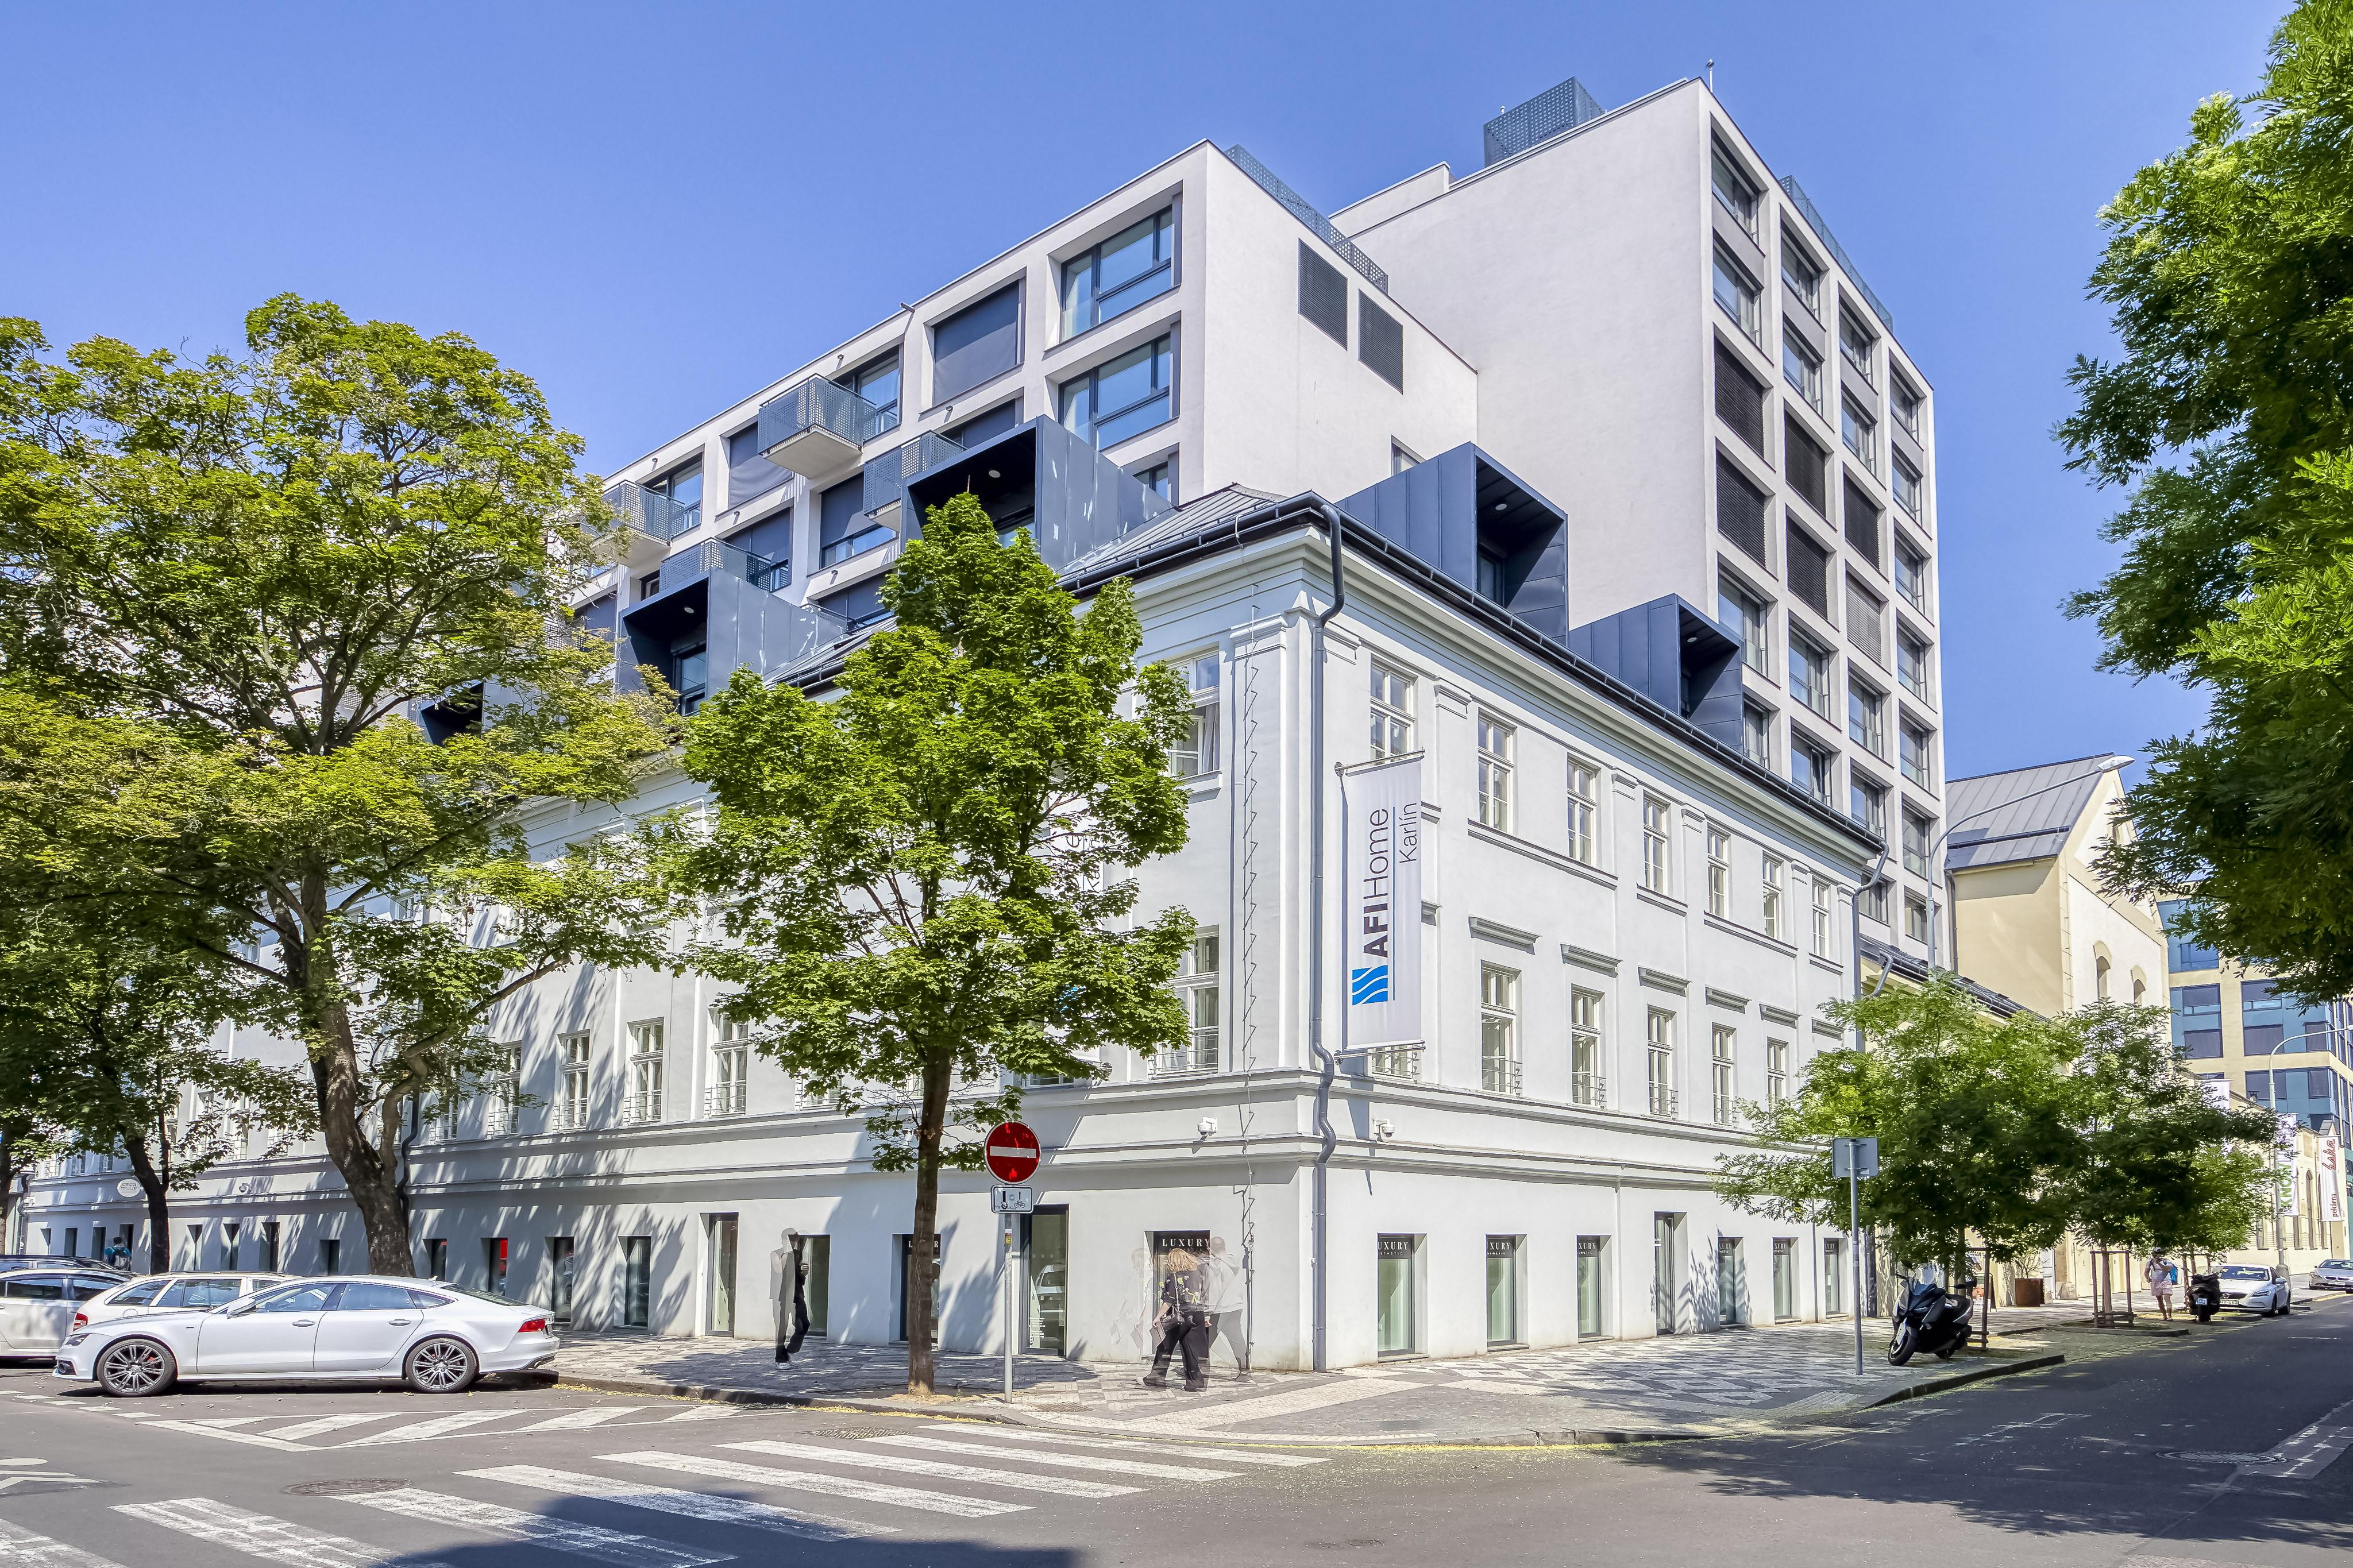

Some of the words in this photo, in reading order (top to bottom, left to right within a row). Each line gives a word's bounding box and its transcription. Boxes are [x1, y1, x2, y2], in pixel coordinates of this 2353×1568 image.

[1399, 802, 1417, 863] Karlín
[2330, 1194, 2339, 1218] pekárna
[1378, 1241, 1408, 1250] UXURY
[1487, 1242, 1510, 1250] XURY
